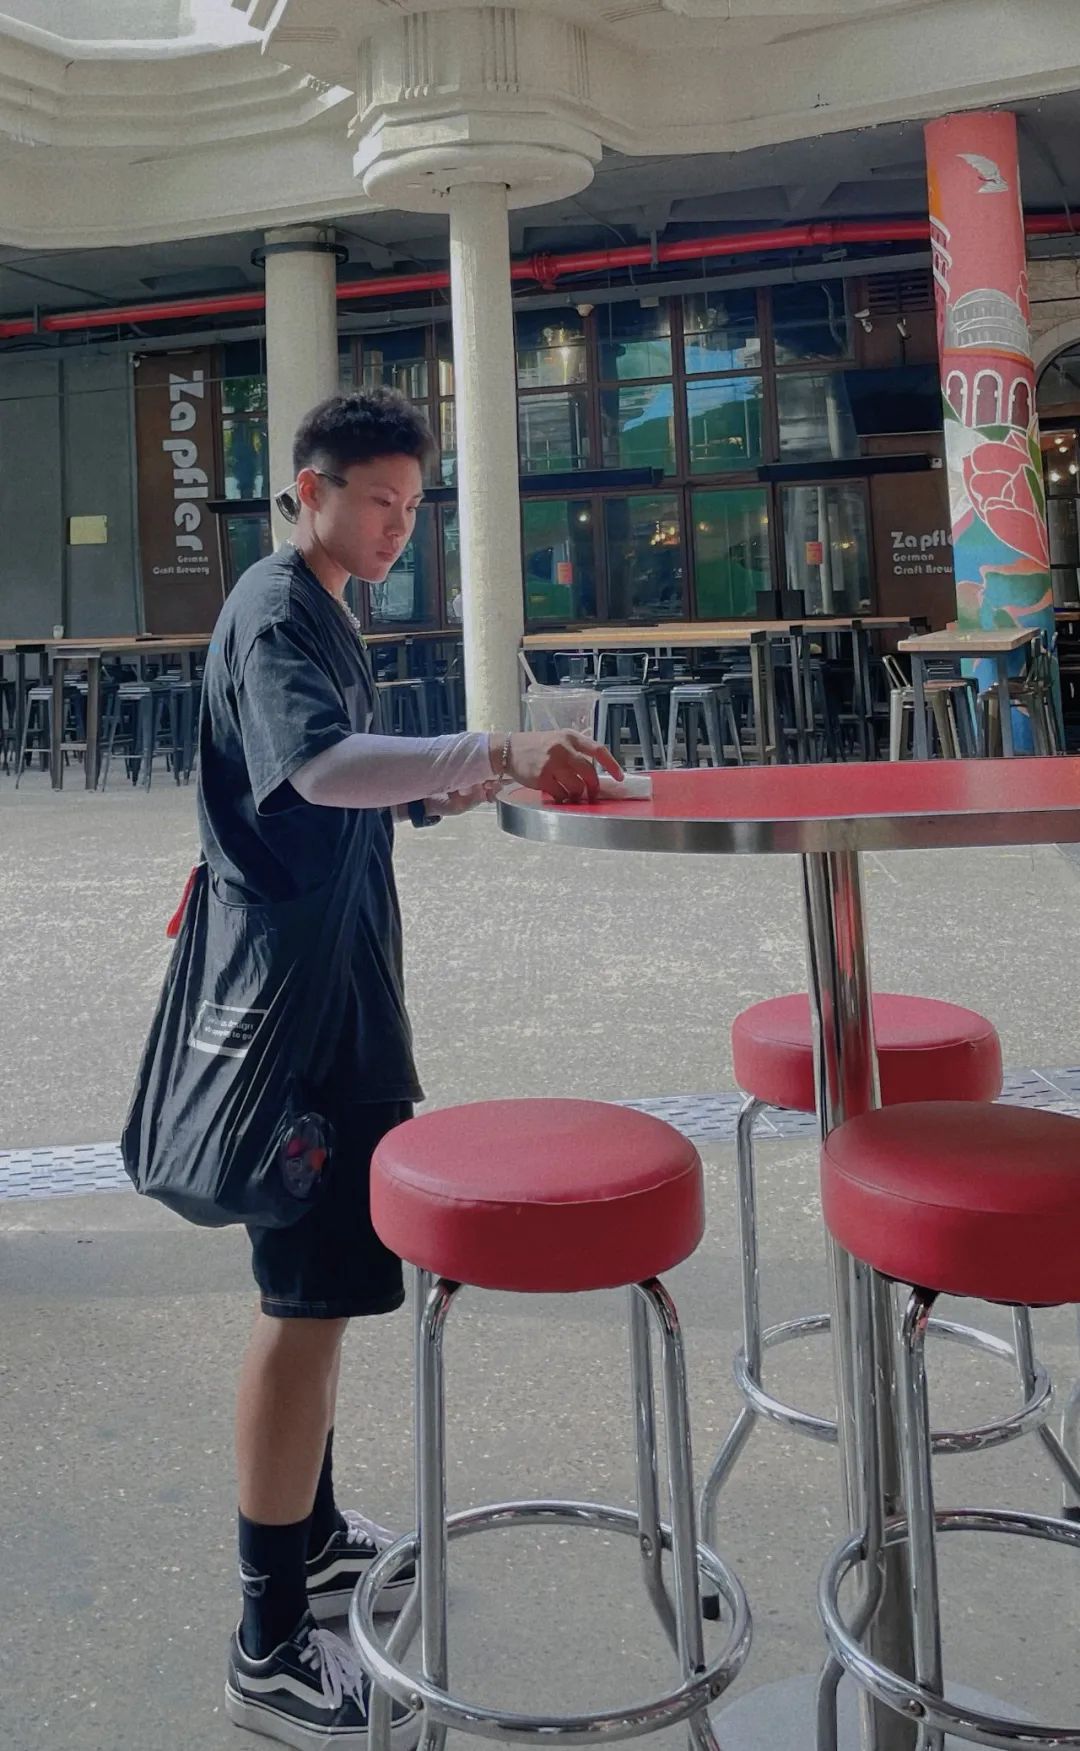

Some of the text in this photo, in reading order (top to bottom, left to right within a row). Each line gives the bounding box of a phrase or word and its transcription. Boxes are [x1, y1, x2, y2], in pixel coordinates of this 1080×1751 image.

[162, 369, 209, 551] Zapfler
[177, 555, 209, 563] German
[892, 553, 935, 562] German
[152, 566, 210, 575] Craft Brewery
[893, 565, 922, 575] Craft
